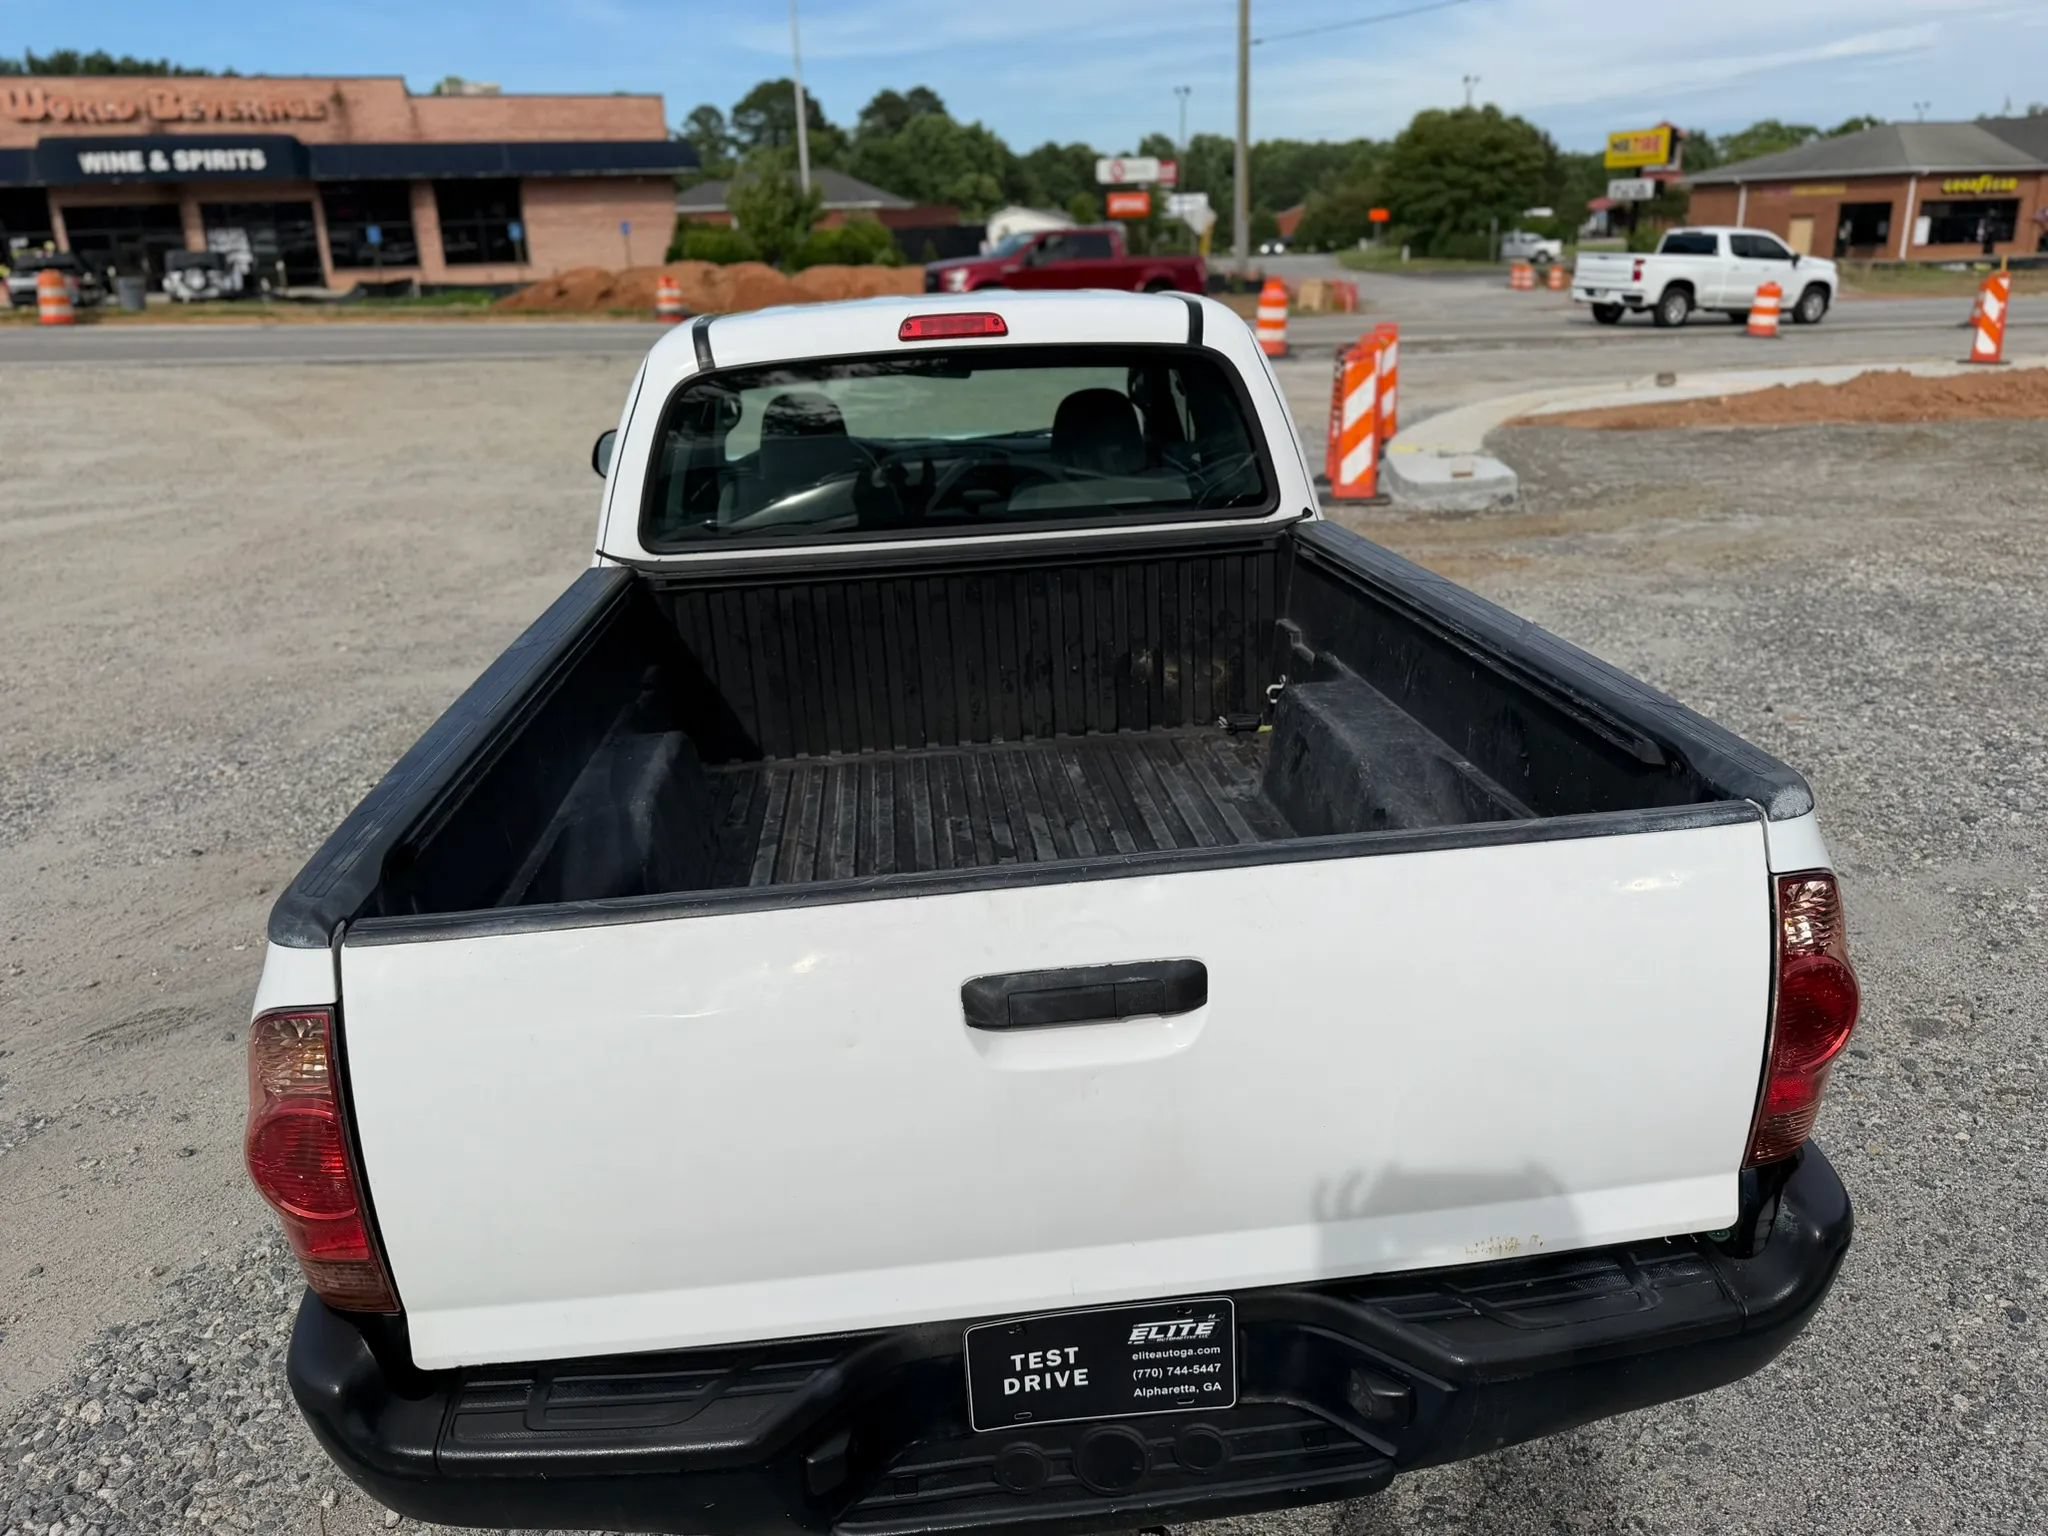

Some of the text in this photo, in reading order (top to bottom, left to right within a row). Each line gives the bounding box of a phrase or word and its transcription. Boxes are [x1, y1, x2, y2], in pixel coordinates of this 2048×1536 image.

[79, 149, 266, 173] WINE & SPIRITS
[1129, 1322, 1215, 1341] ELITE
[1010, 1346, 1079, 1372] TEST
[1132, 1346, 1221, 1361] eliteautoga.com
[1003, 1368, 1089, 1395] DRIVE
[1132, 1363, 1221, 1382] (770) 744-5447
[1133, 1381, 1222, 1398] Alpharetta, GA
